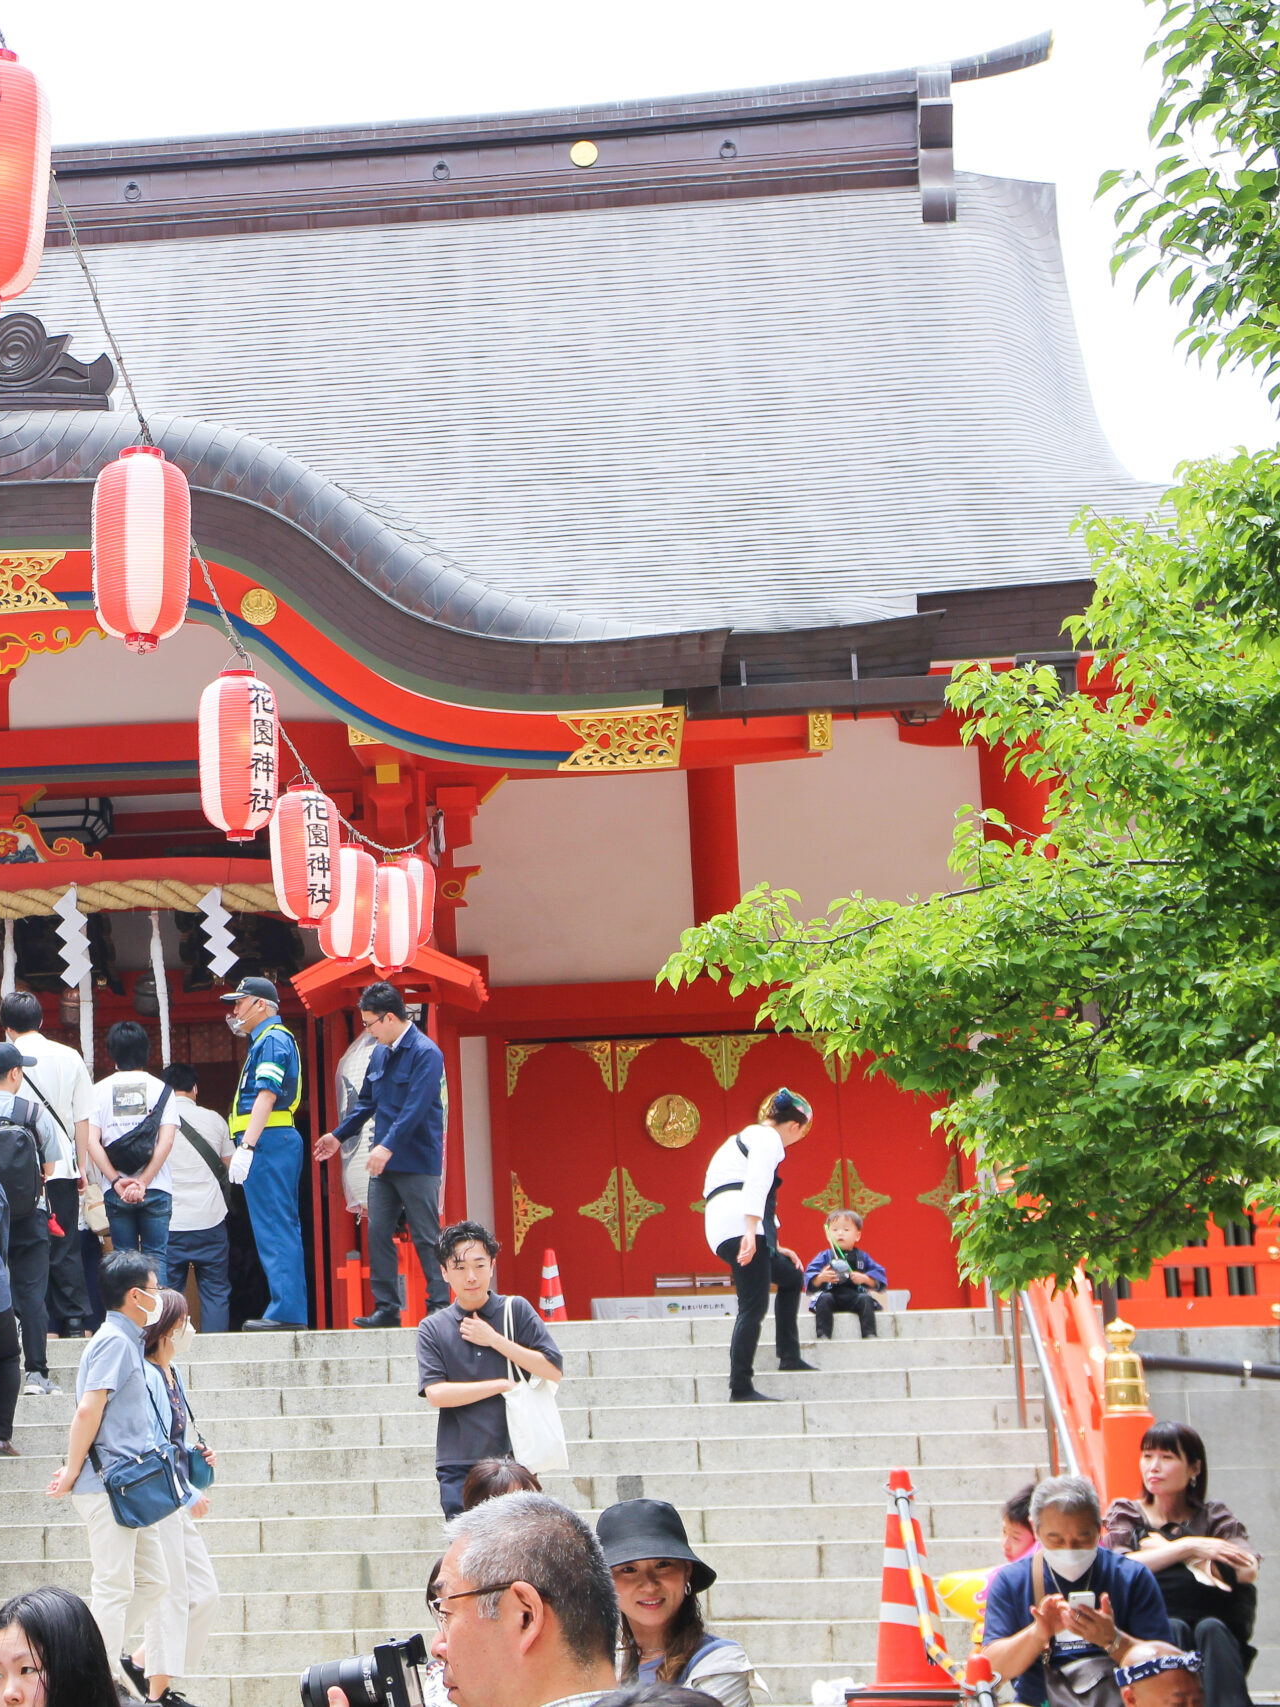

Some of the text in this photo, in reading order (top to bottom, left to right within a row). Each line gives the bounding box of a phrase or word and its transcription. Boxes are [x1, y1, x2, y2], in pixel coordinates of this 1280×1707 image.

[244, 683, 275, 814] 花園神社
[301, 795, 331, 905] 花園神社
